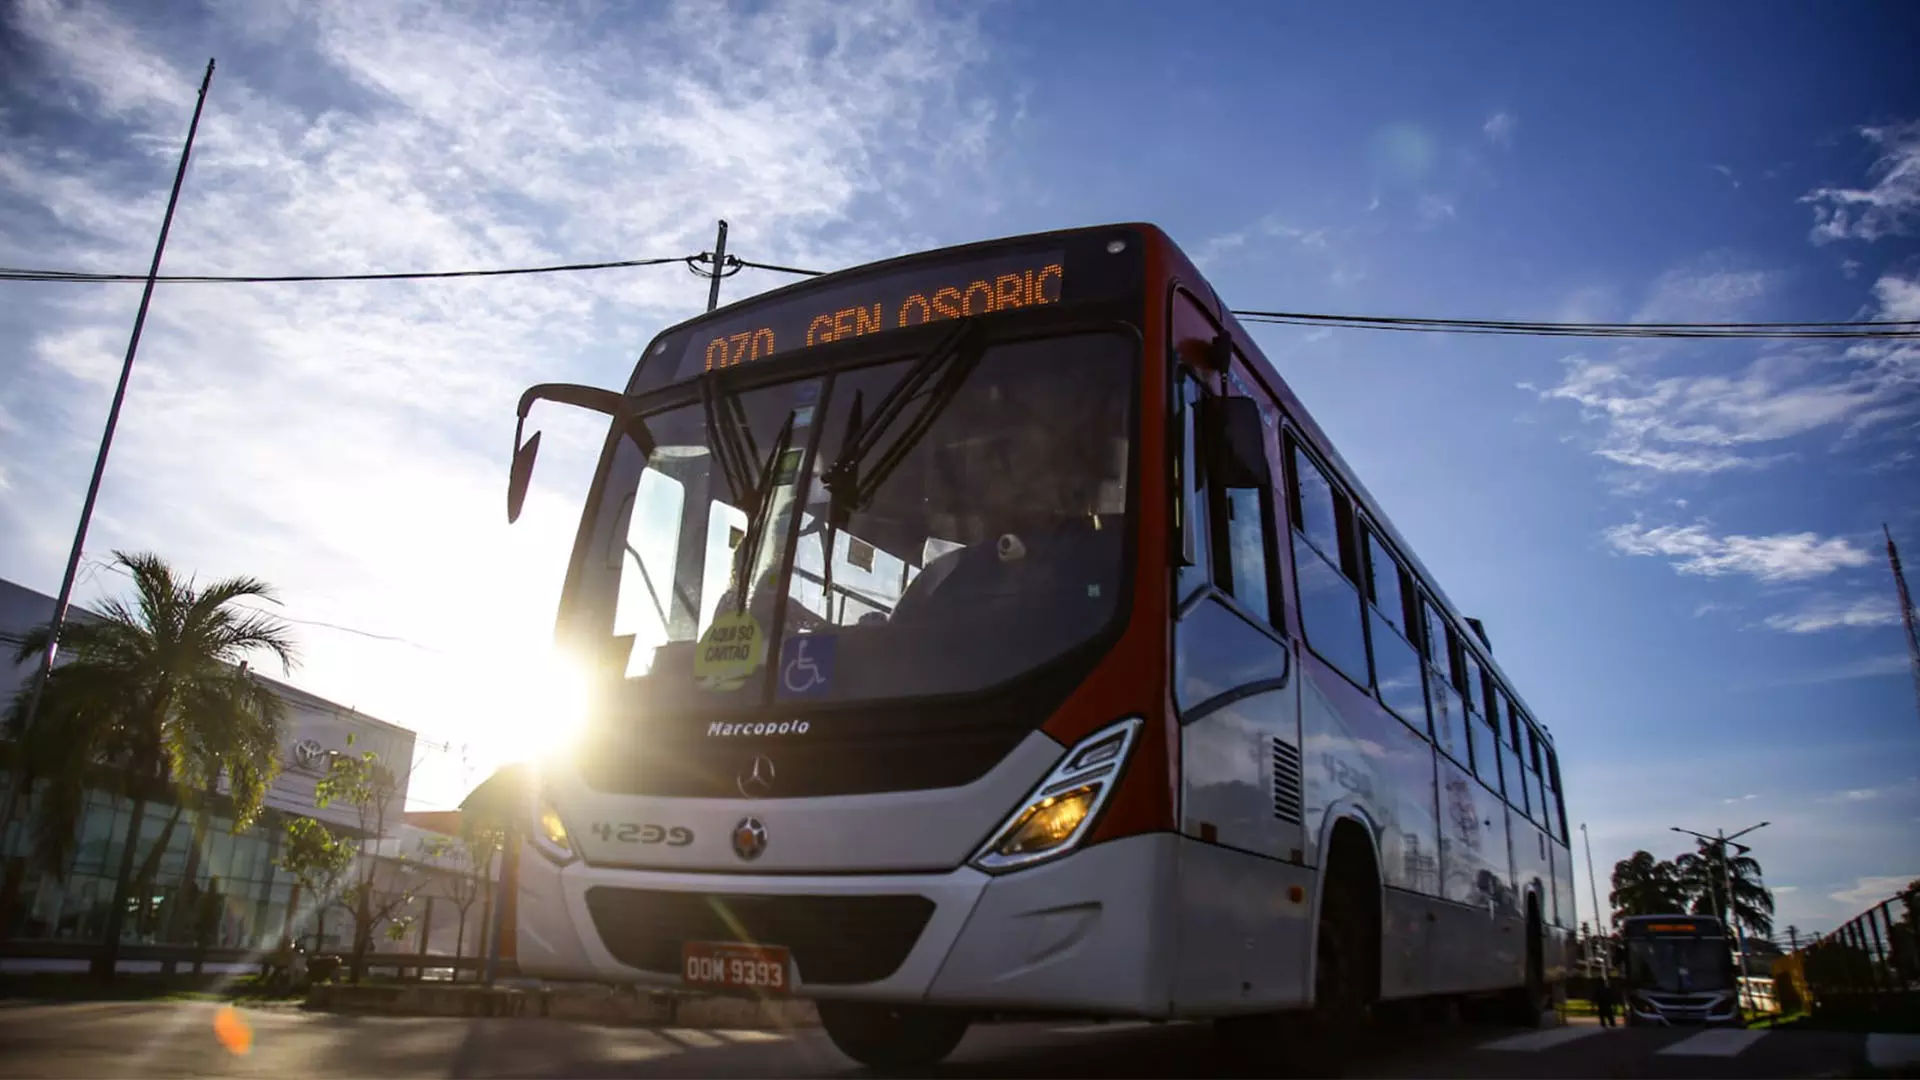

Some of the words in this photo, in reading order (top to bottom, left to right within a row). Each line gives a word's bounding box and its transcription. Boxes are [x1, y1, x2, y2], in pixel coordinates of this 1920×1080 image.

[806, 302, 882, 348] GEN
[707, 719, 811, 737] Marcopolo
[591, 821, 695, 847] 4239
[731, 959, 783, 987] 9393
